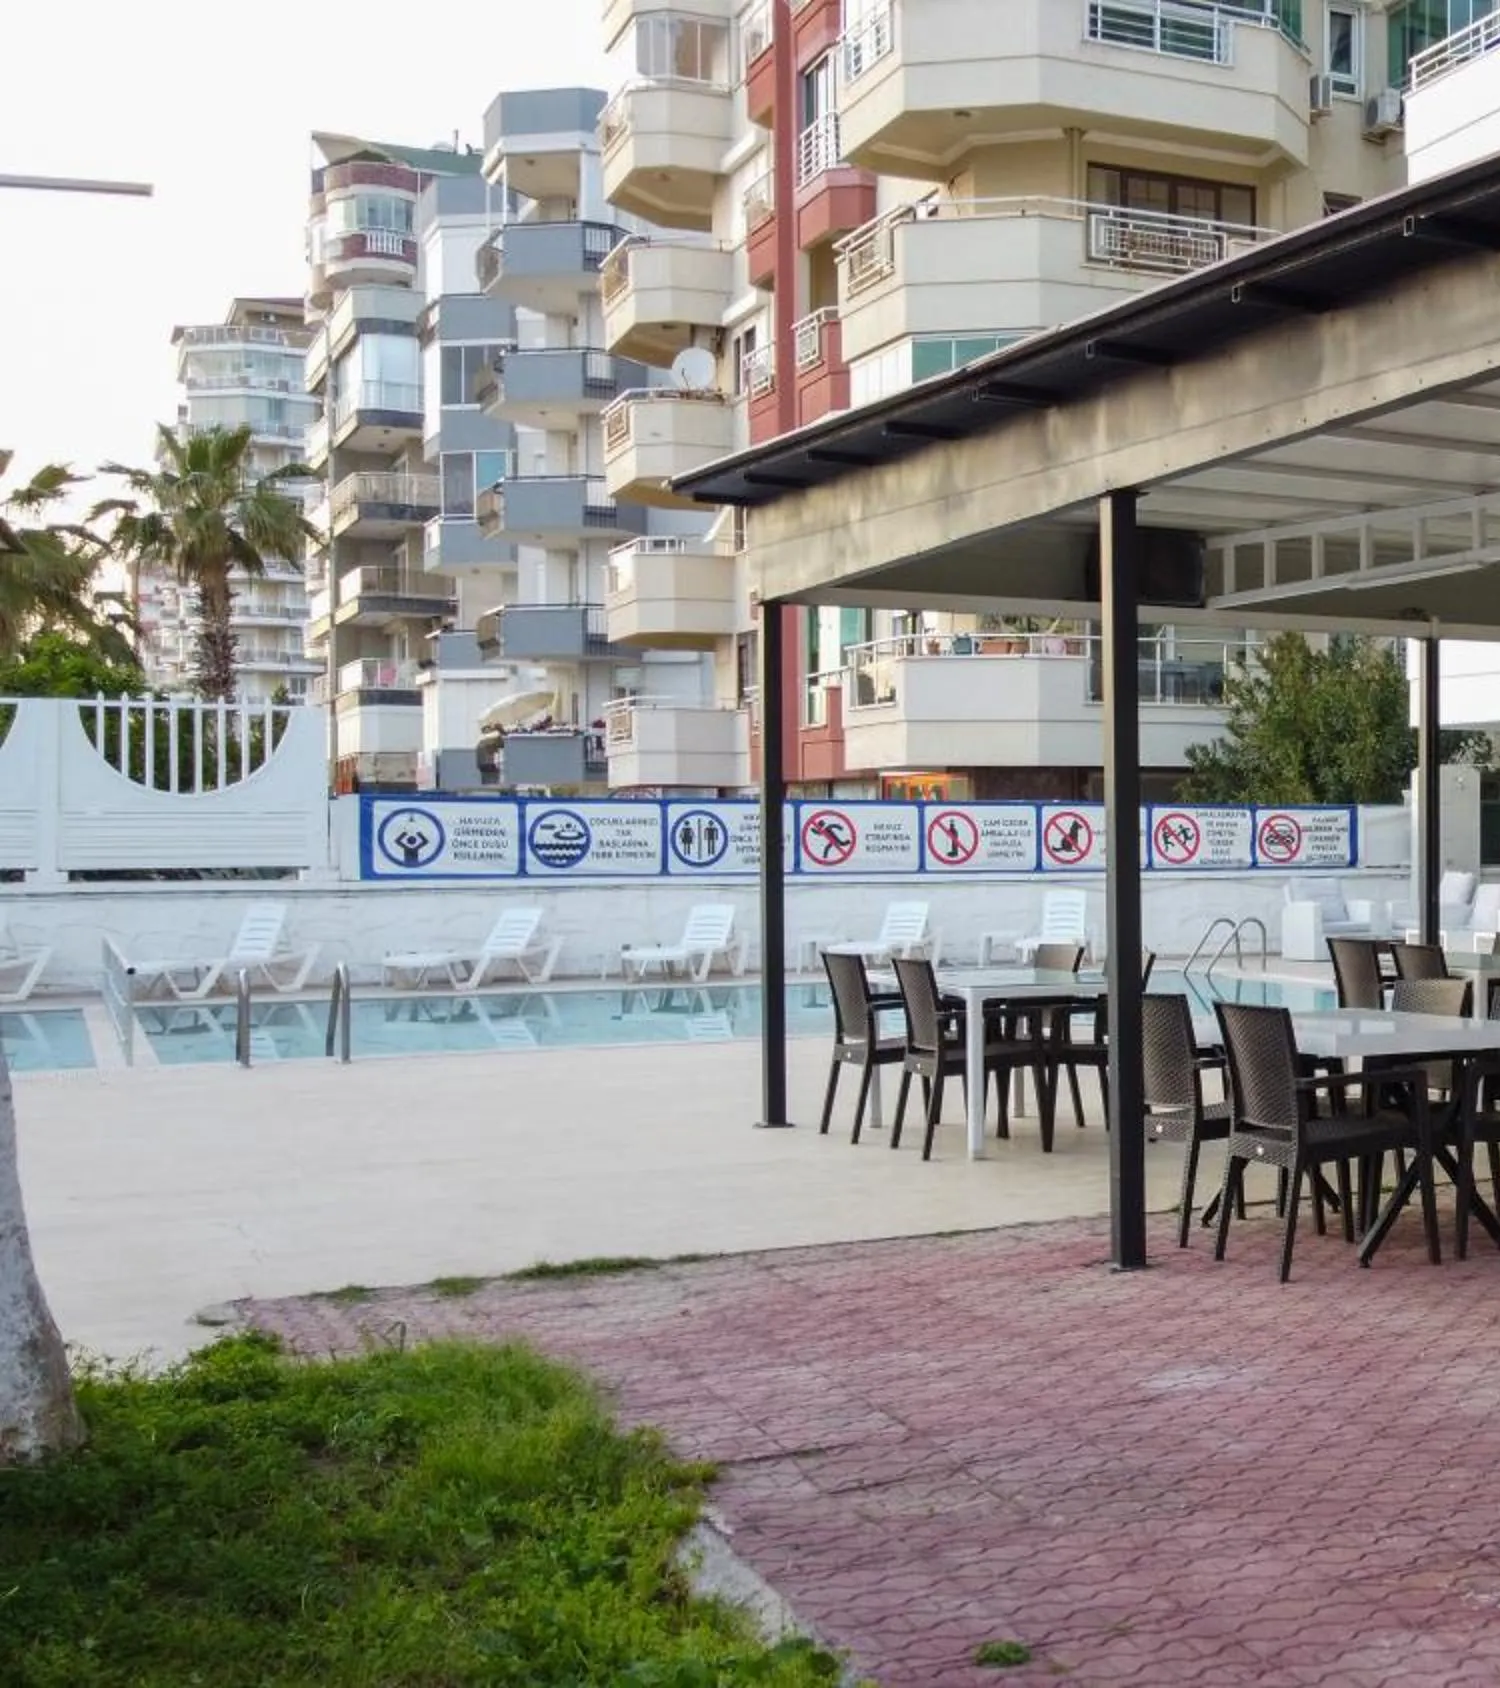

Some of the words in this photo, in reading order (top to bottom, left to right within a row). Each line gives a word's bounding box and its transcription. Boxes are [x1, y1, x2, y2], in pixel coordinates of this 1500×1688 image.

[459, 816, 501, 825] HAVUZA
[453, 826, 506, 837] GİRMEDEN
[451, 838, 479, 849] ÖNCE
